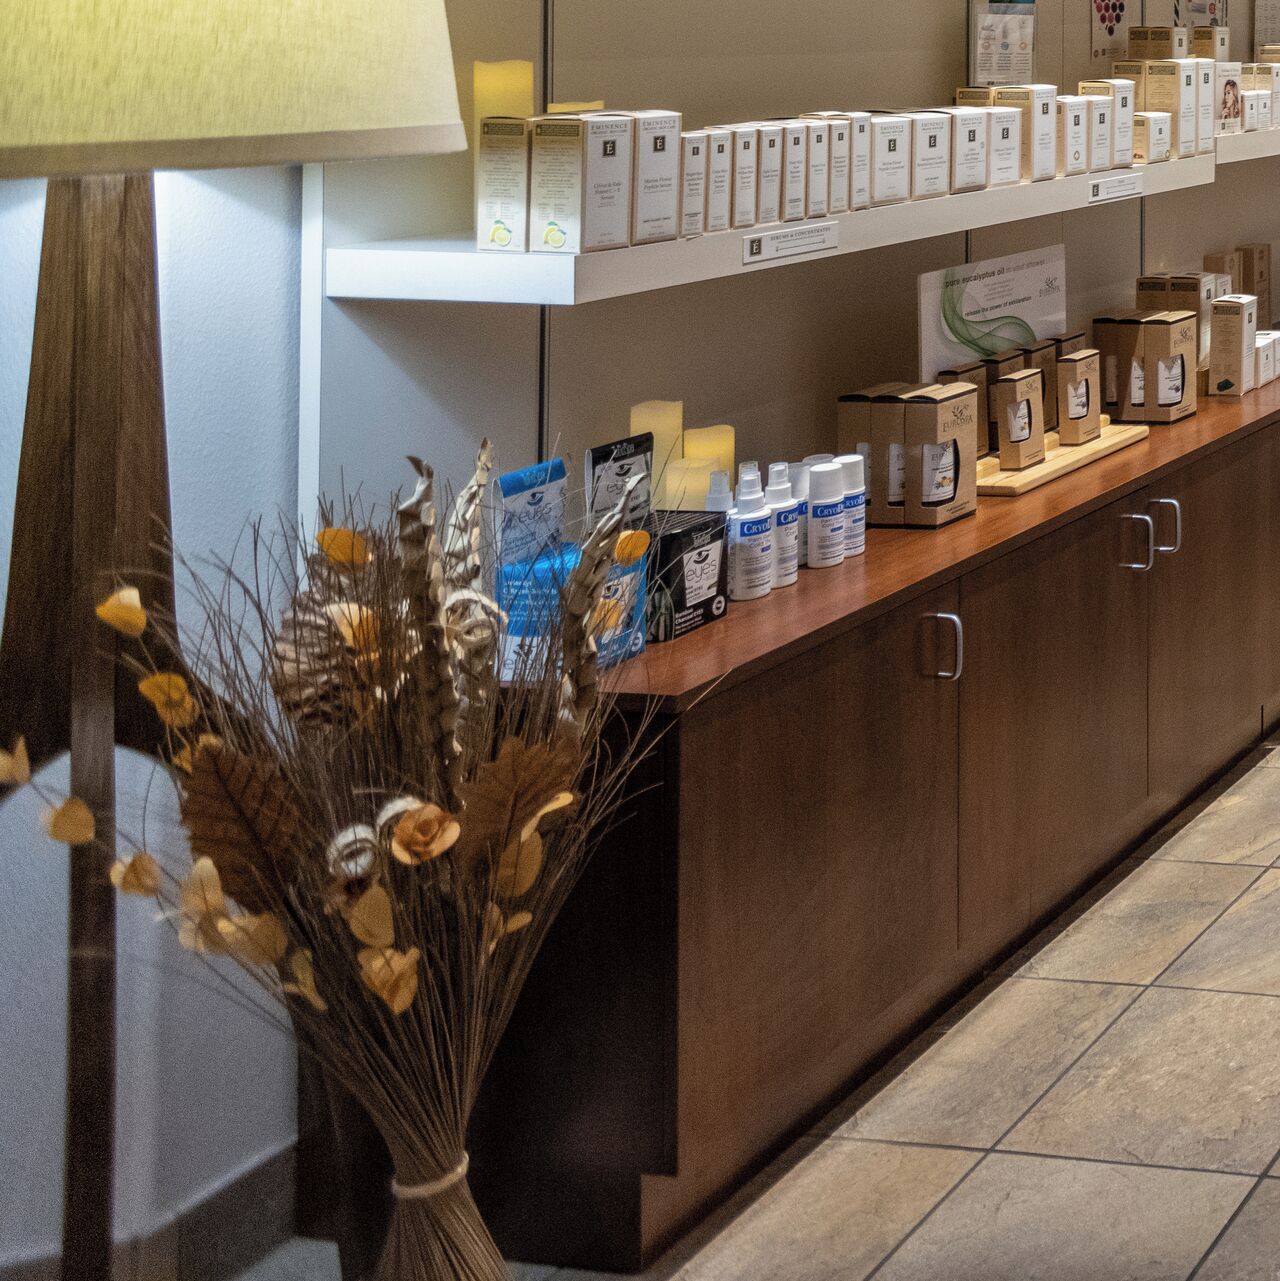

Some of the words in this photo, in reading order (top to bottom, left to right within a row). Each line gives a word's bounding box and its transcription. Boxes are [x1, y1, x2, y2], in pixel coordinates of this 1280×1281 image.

[770, 232, 789, 242] SERUMS
[794, 226, 831, 238] CONCENTRATES
[945, 278, 961, 289] pure
[962, 270, 996, 285] eucalyptus
[996, 267, 1005, 276] oil
[964, 308, 981, 317] release
[981, 306, 989, 314] the
[989, 304, 1003, 313] power
[1008, 295, 1032, 306] exhilaration
[943, 414, 974, 433] EUROSPA
[685, 558, 718, 583] eyes
